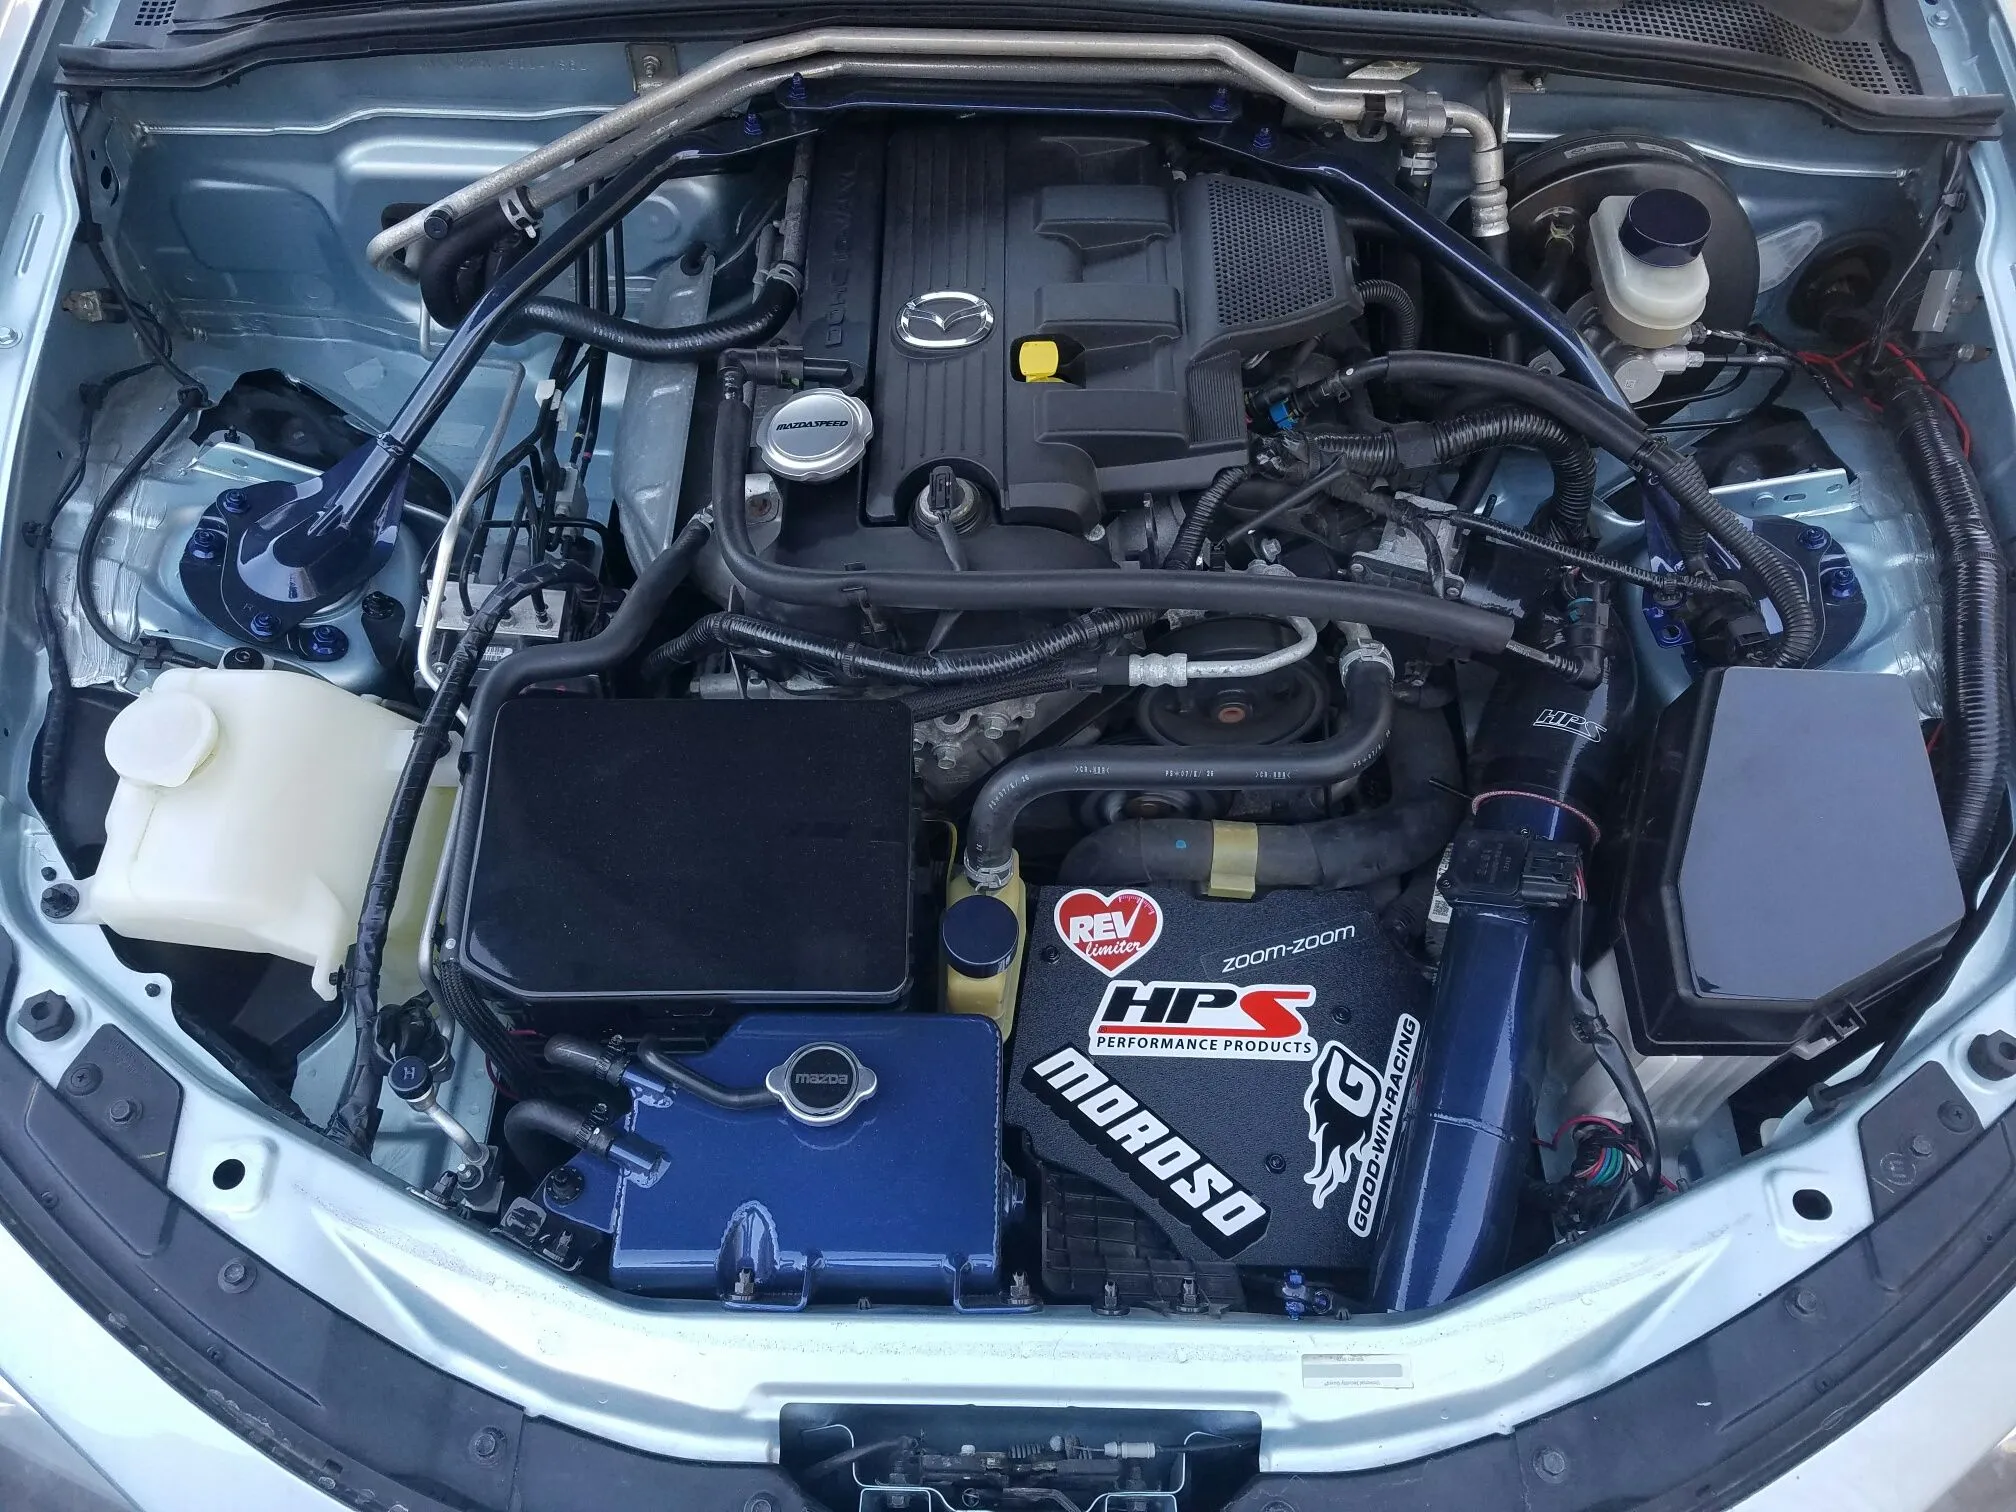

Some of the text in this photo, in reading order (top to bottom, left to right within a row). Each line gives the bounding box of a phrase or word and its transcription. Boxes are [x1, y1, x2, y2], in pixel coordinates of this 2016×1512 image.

[775, 420, 849, 431] MAZDASPEED
[1533, 708, 1608, 742] HPS
[1069, 903, 1140, 944] REV
[1085, 940, 1141, 957] limiter
[1221, 924, 1355, 973] zoom-zoom
[1097, 986, 1311, 1038] HPS
[1096, 1036, 1312, 1054] PERFORMANCE PRODUCTS
[403, 1066, 415, 1080] H
[1032, 1047, 1266, 1237] MOROSO
[1354, 1017, 1416, 1232] GOOD-WIN-RACING
